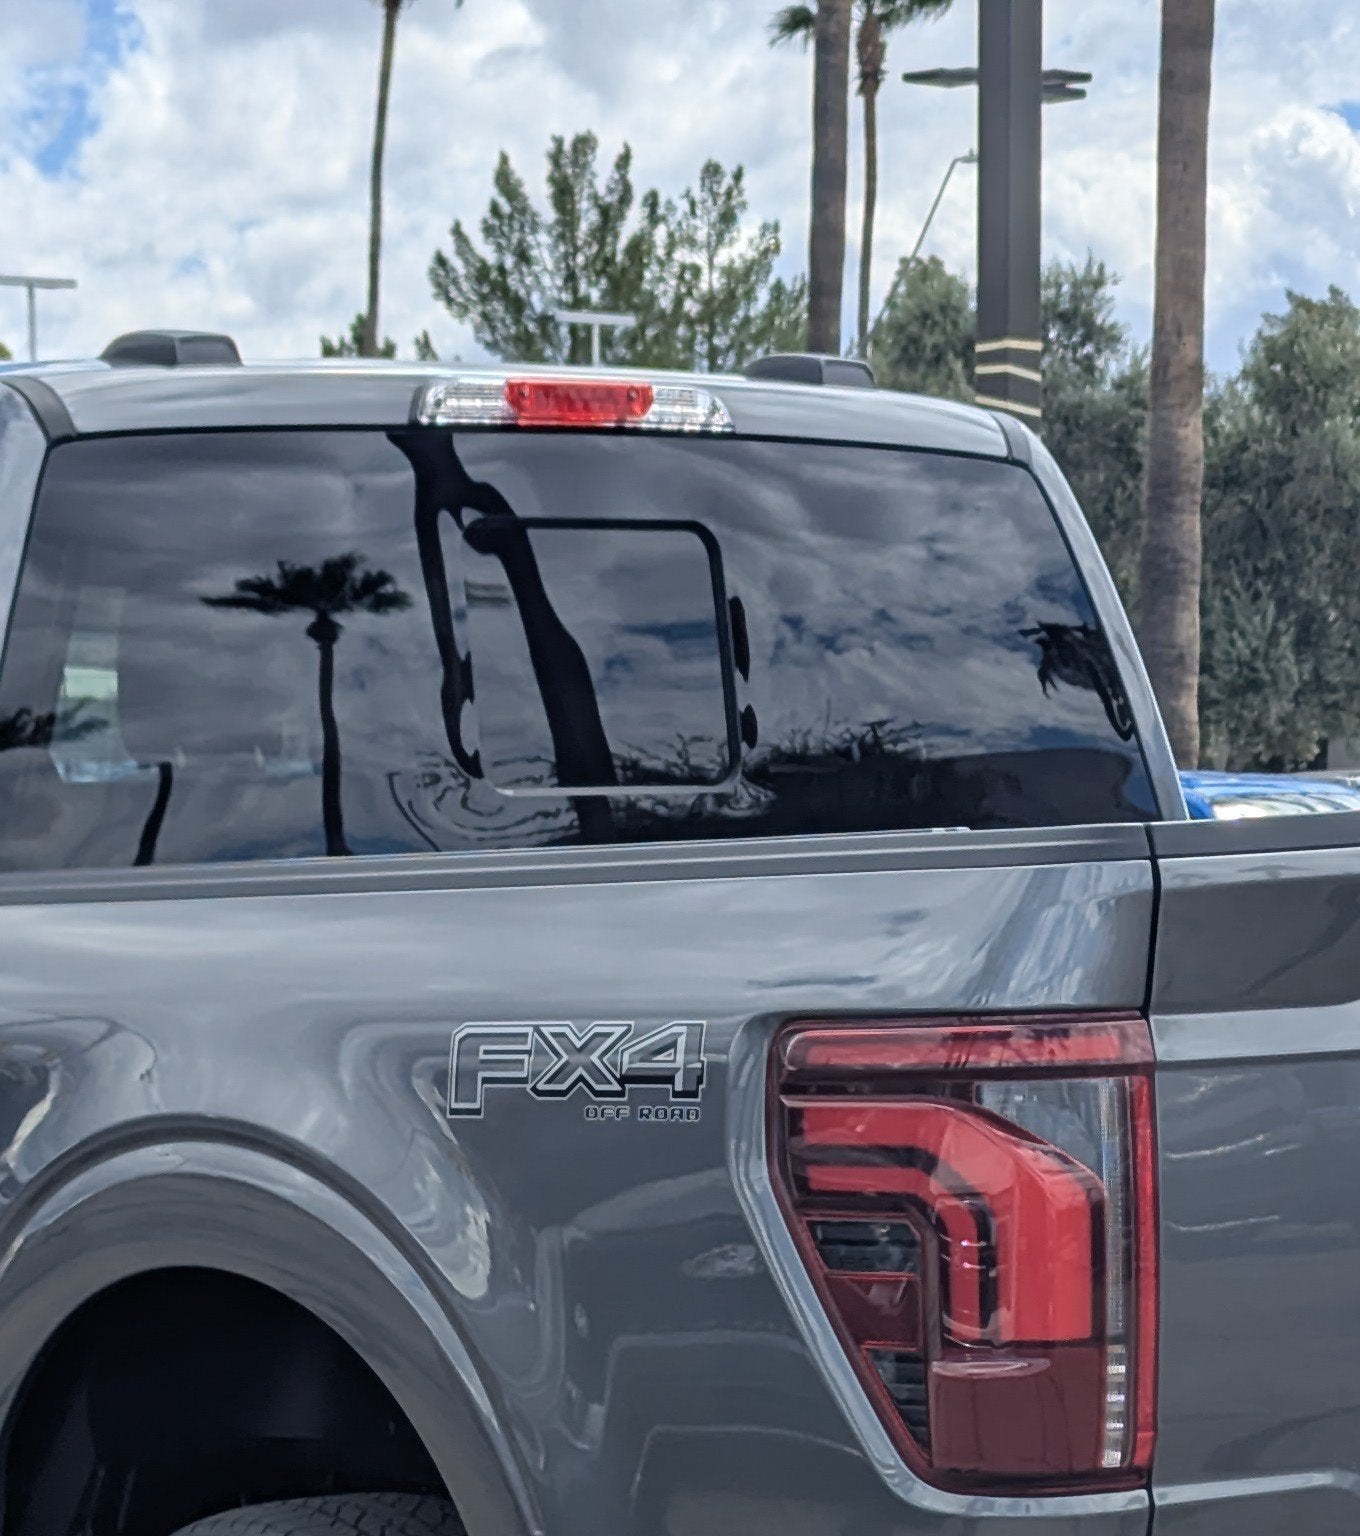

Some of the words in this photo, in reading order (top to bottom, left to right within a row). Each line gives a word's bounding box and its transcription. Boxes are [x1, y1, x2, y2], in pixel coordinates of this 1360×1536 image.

[446, 1020, 706, 1118] FX4
[585, 1105, 630, 1121] OFF
[638, 1105, 701, 1122] ROAD
